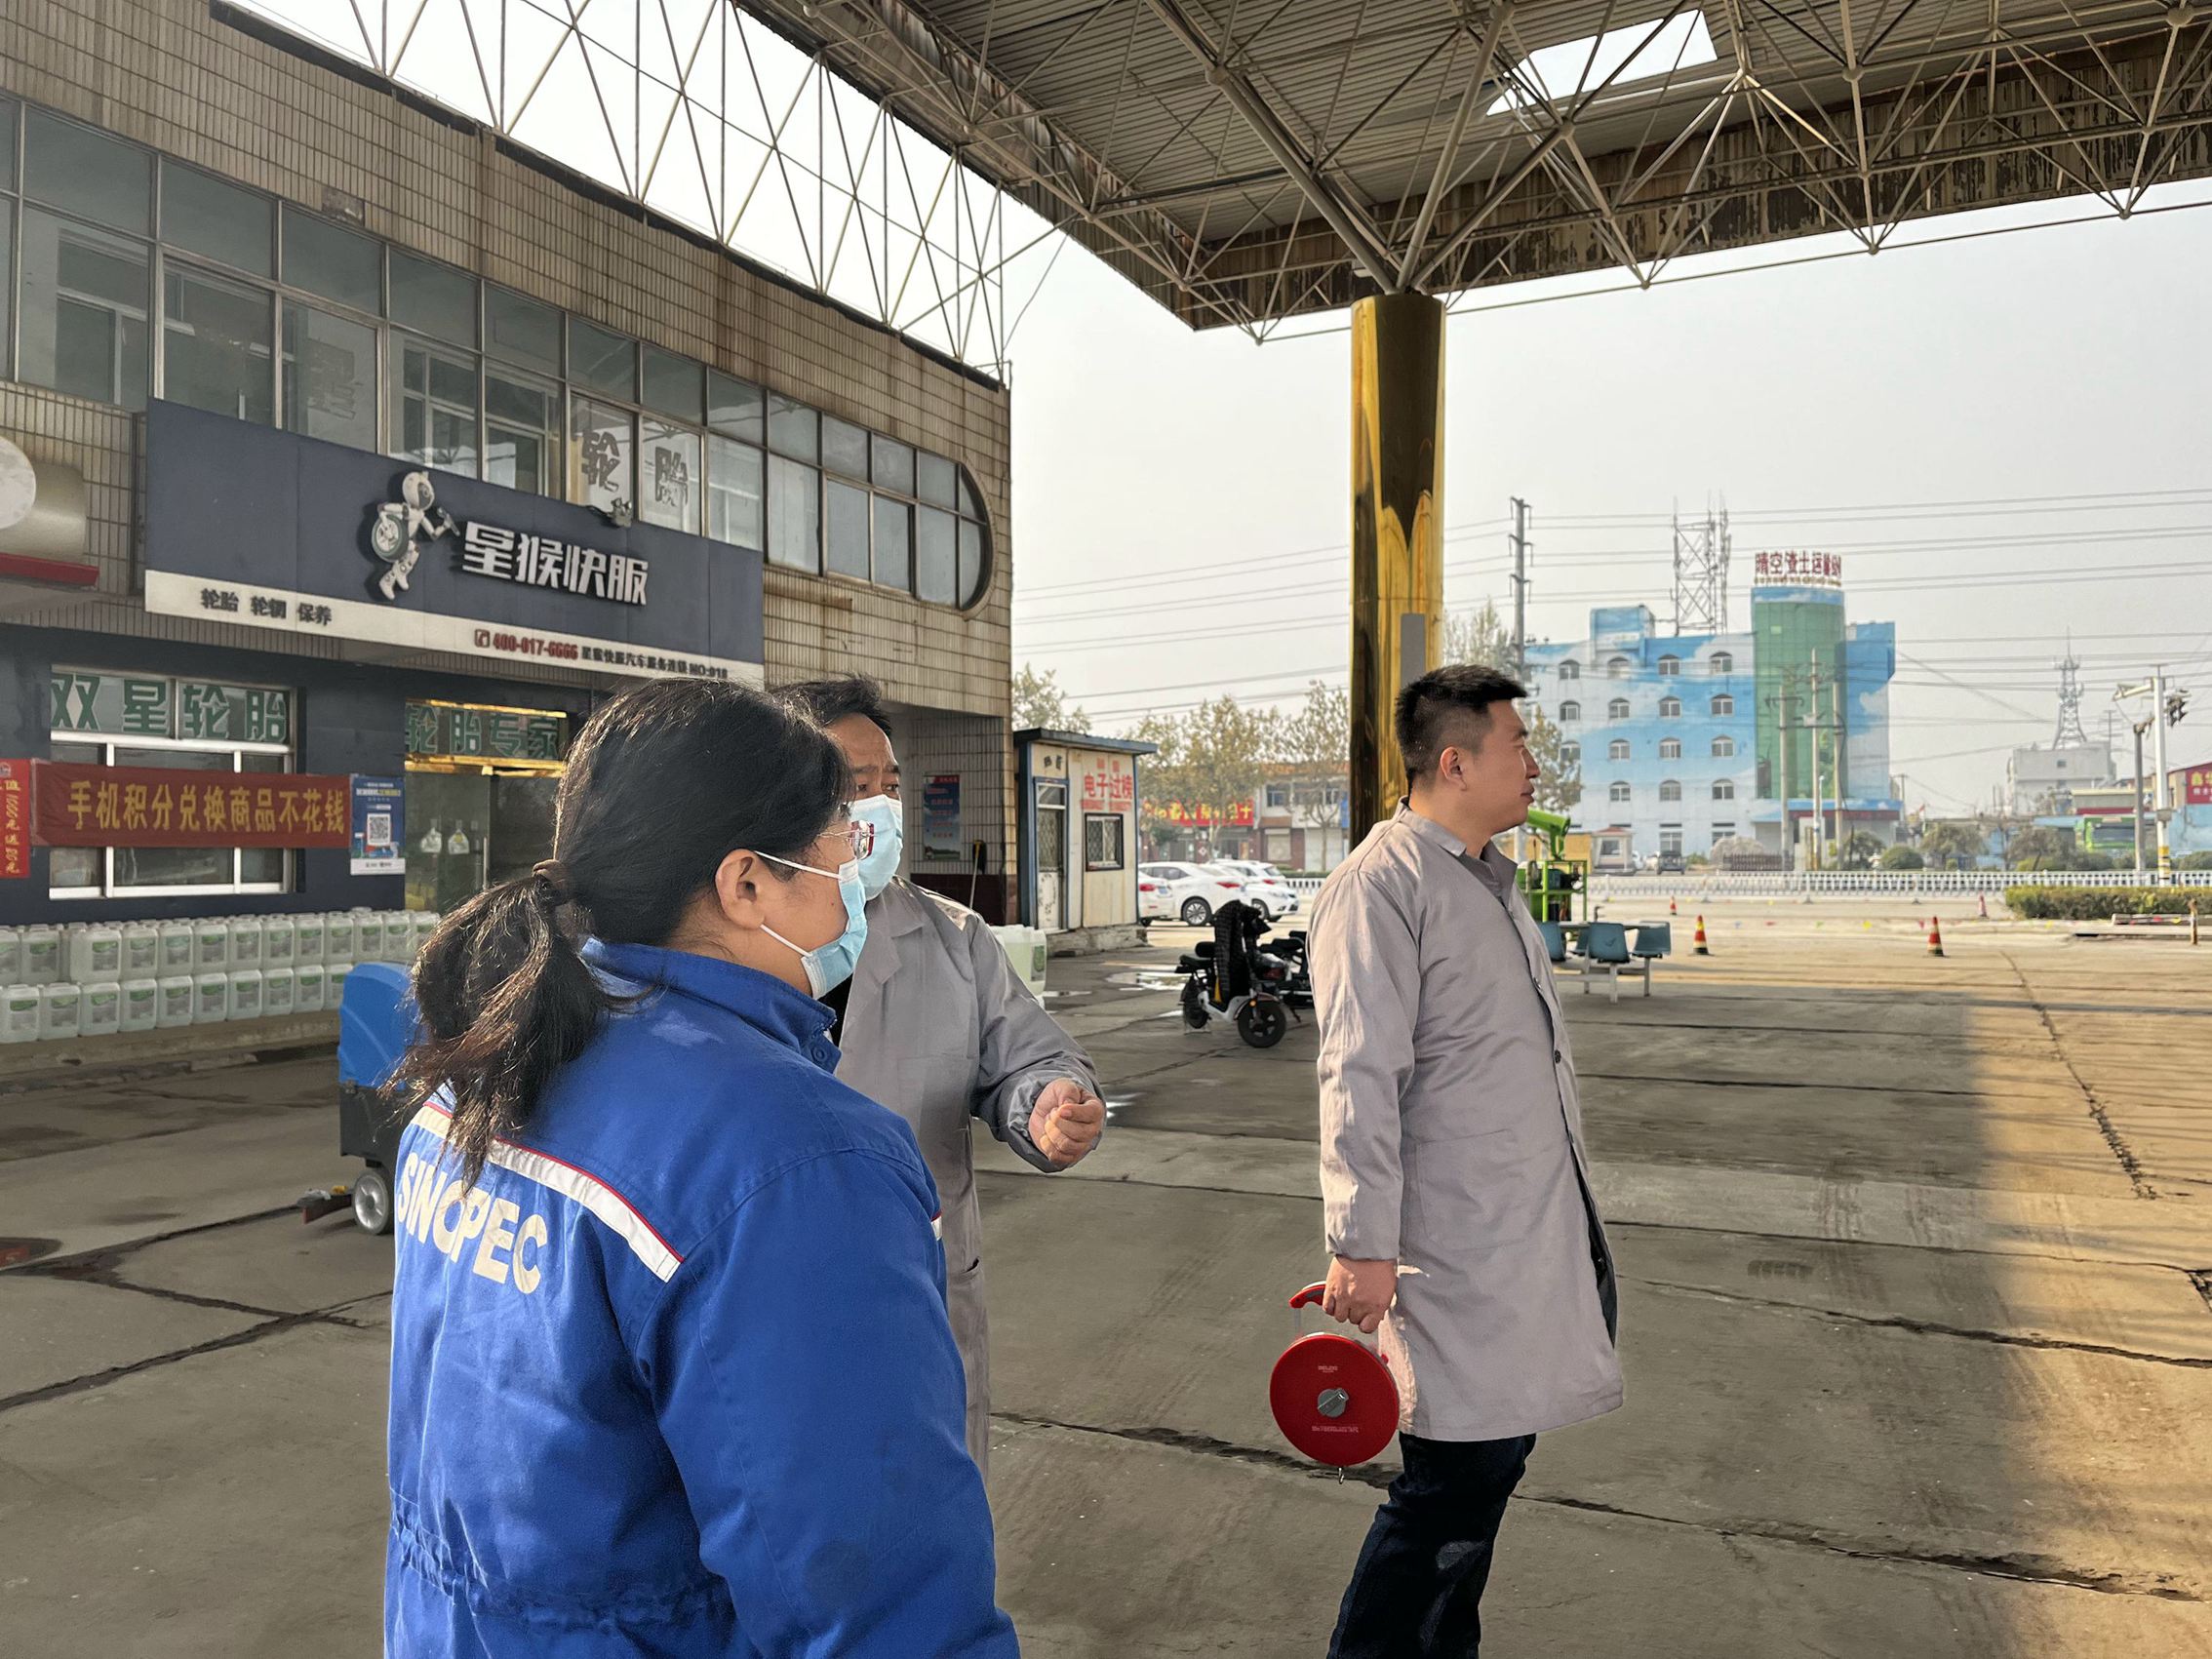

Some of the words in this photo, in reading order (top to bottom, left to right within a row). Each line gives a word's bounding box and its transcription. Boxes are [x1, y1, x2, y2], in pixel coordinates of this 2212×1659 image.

[462, 521, 649, 606] 星猴快服
[201, 588, 239, 612] 轮胎
[297, 602, 332, 626] 保养
[52, 674, 287, 743] 双星轮胎
[406, 703, 559, 760] 轮胎专家
[67, 779, 345, 834] 手机积分兑换商品不花钱
[396, 1152, 548, 1295] SINOPEC
